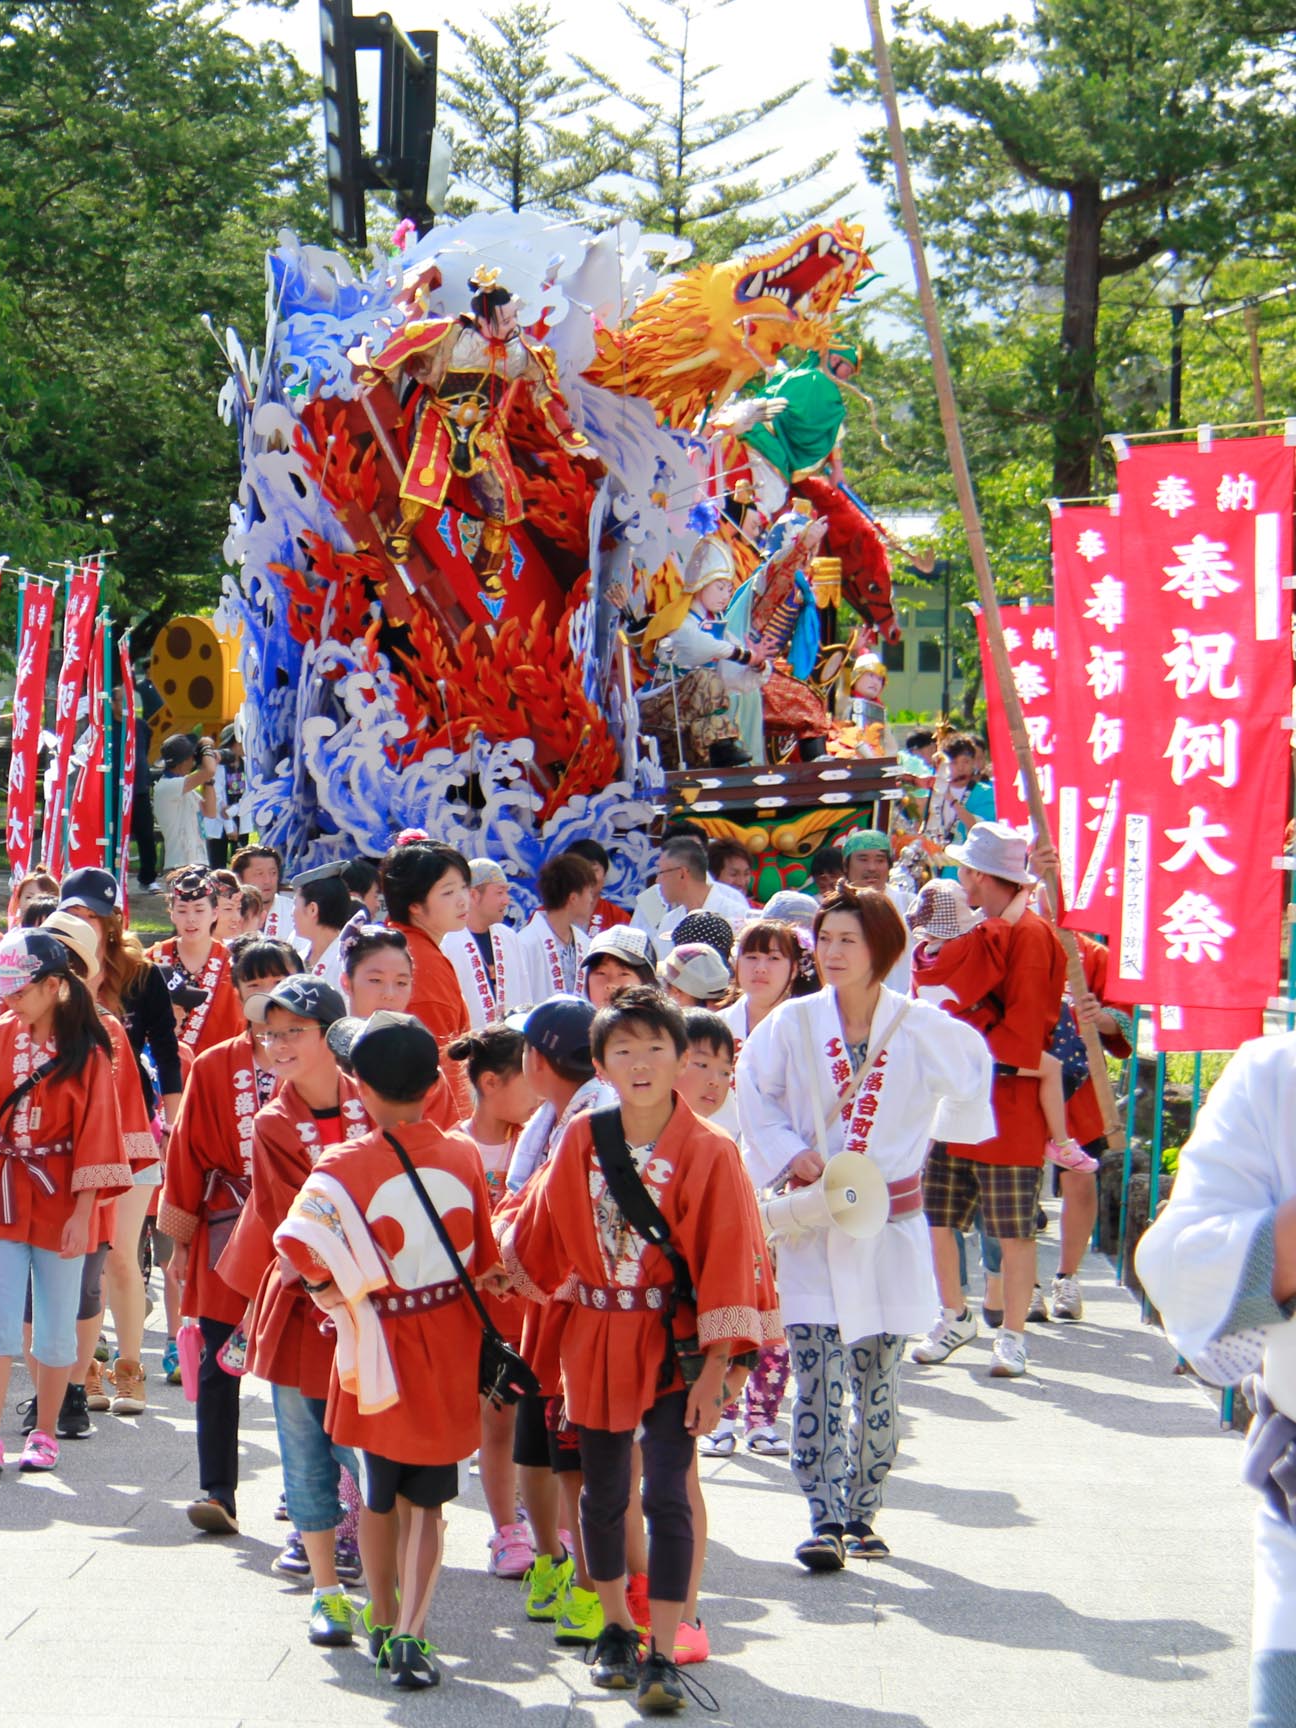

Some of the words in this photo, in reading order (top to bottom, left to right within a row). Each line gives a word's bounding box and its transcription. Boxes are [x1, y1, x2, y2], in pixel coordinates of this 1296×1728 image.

[1151, 473, 1257, 518] 奉納
[1076, 529, 1106, 562] 奉
[1157, 533, 1242, 963] 奉祝例大祭
